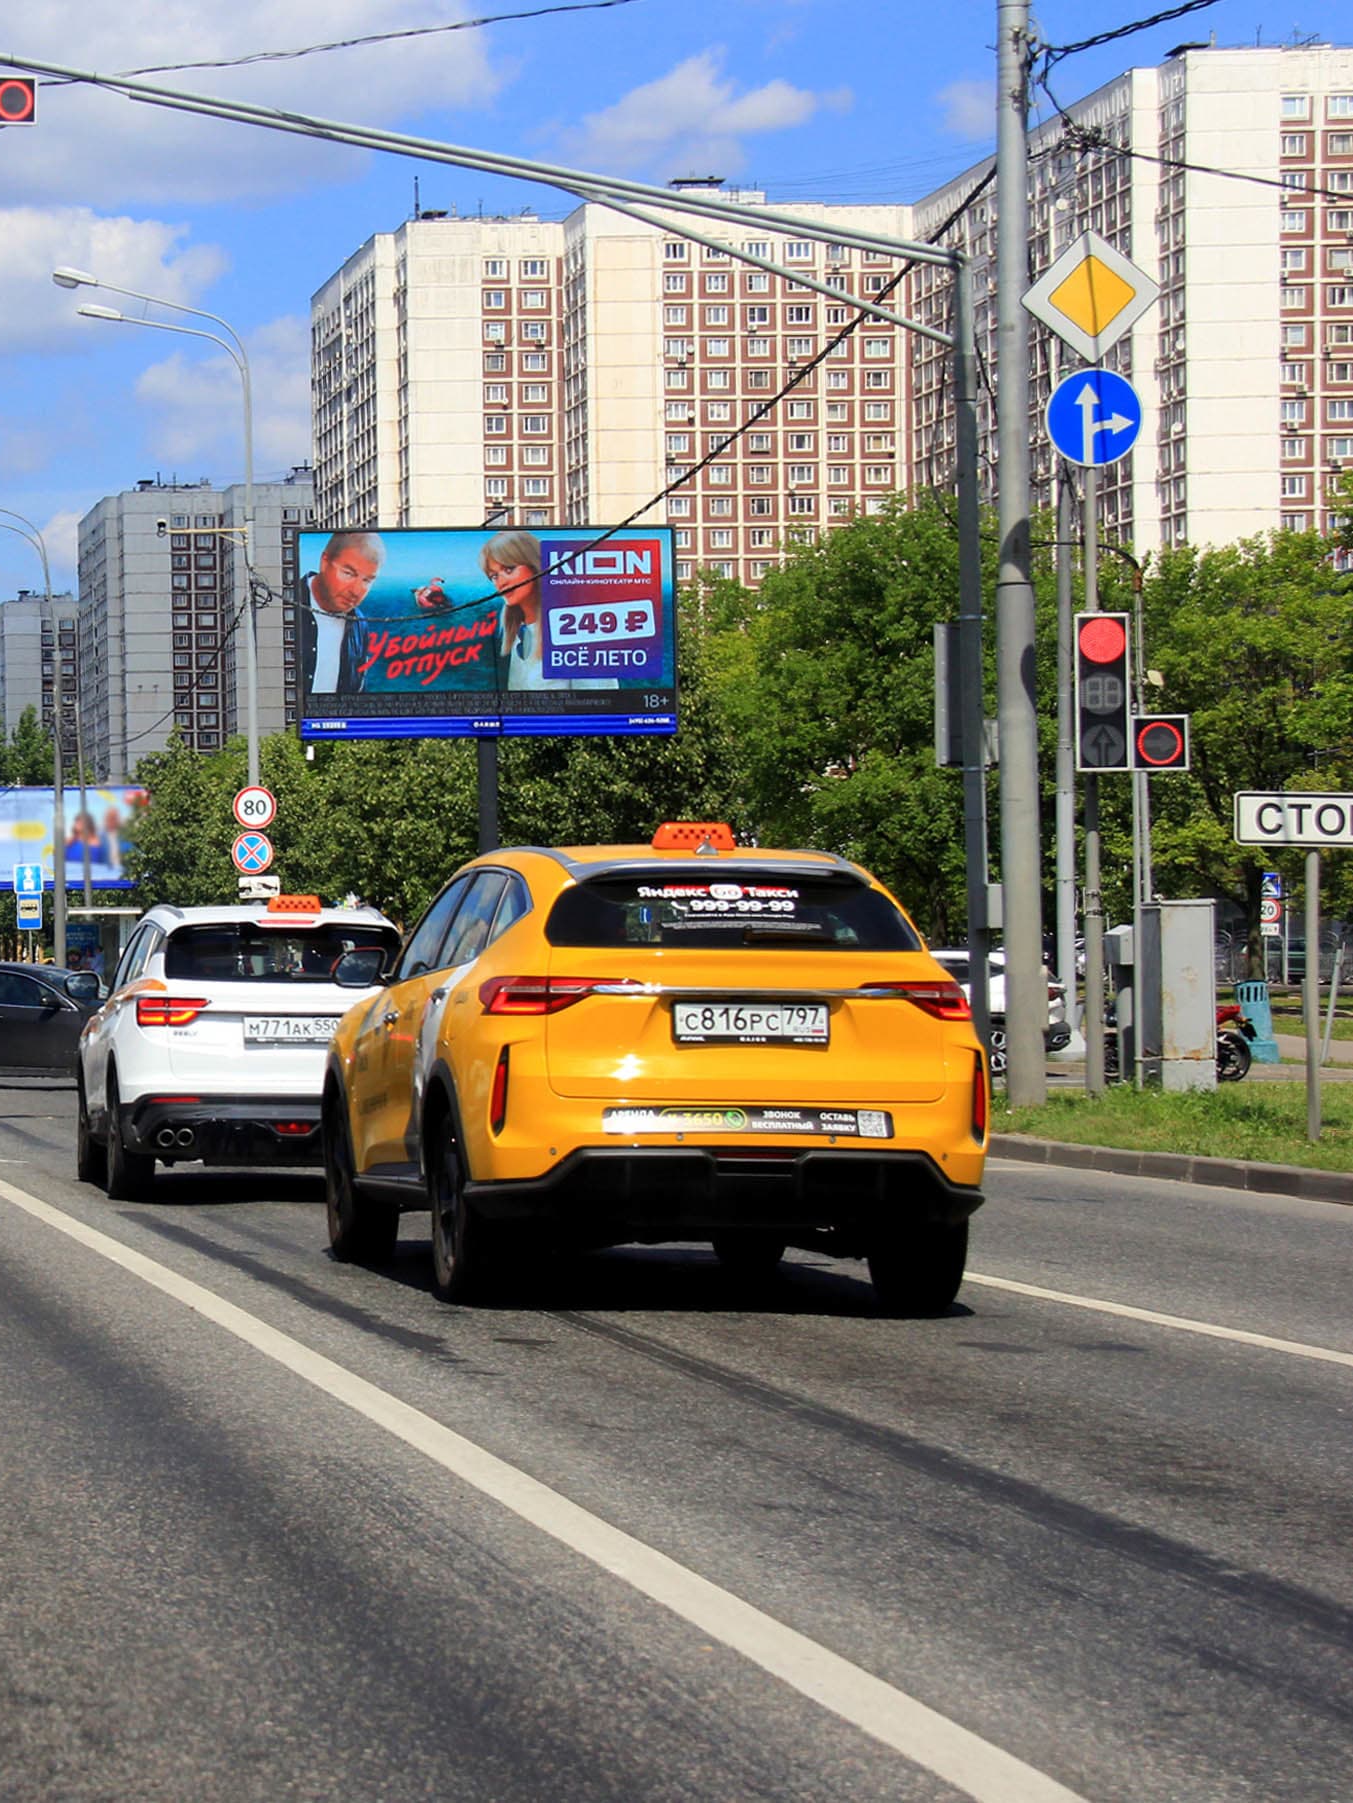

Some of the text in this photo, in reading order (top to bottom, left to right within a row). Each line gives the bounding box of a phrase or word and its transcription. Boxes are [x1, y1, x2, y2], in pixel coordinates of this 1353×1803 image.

[550, 551, 651, 575] KION
[559, 611, 648, 635] 249 ₽
[551, 646, 647, 666] ВСЁ ЛЕТО
[644, 694, 669, 708] 18+
[243, 800, 266, 815] 80
[1256, 803, 1353, 836] СТО
[637, 886, 707, 898] Яндекс
[744, 887, 798, 898] Такси
[690, 901, 795, 912] 999-99-99
[784, 1007, 819, 1025] 797
[763, 1110, 800, 1119] ЗВОНОК
